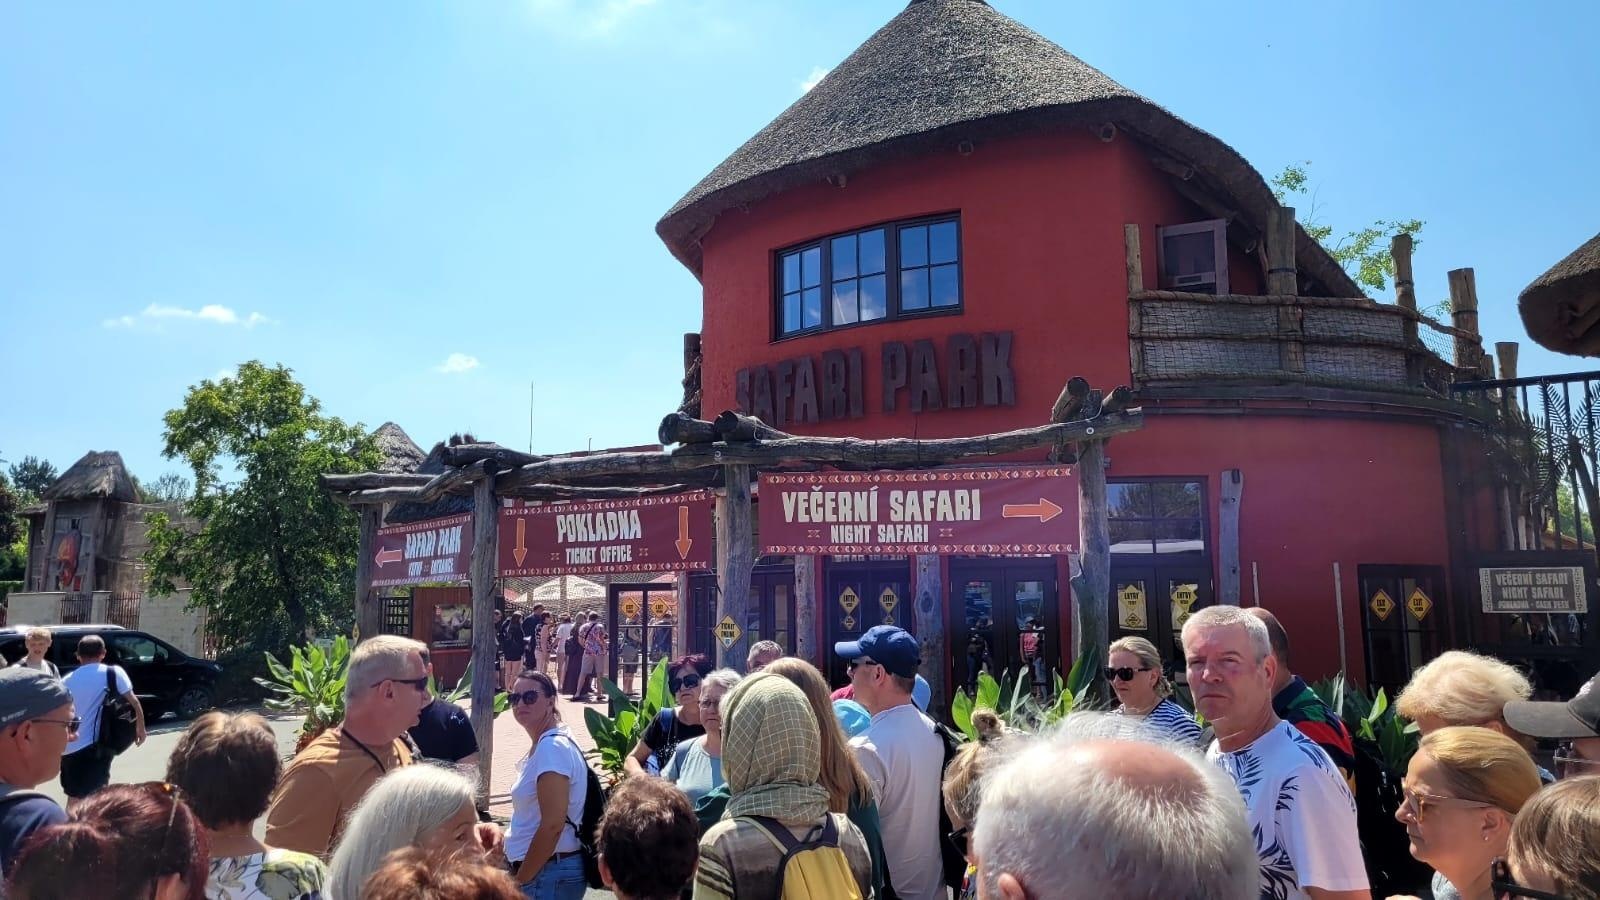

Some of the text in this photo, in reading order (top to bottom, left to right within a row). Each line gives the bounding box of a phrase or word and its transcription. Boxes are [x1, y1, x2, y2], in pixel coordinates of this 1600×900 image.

[735, 330, 1016, 426] SAFARI PARK
[781, 485, 981, 523] VEČERNÍ SAFARI
[556, 509, 642, 544] POKLADNA
[831, 524, 929, 544] NIGHT SAFARI
[404, 525, 463, 560] SAFARI PARK
[565, 544, 633, 565] TICKET OFFICE
[1495, 570, 1569, 586] VEČERNÍ SAFARI
[1502, 586, 1565, 600] NIGHT SAFARI
